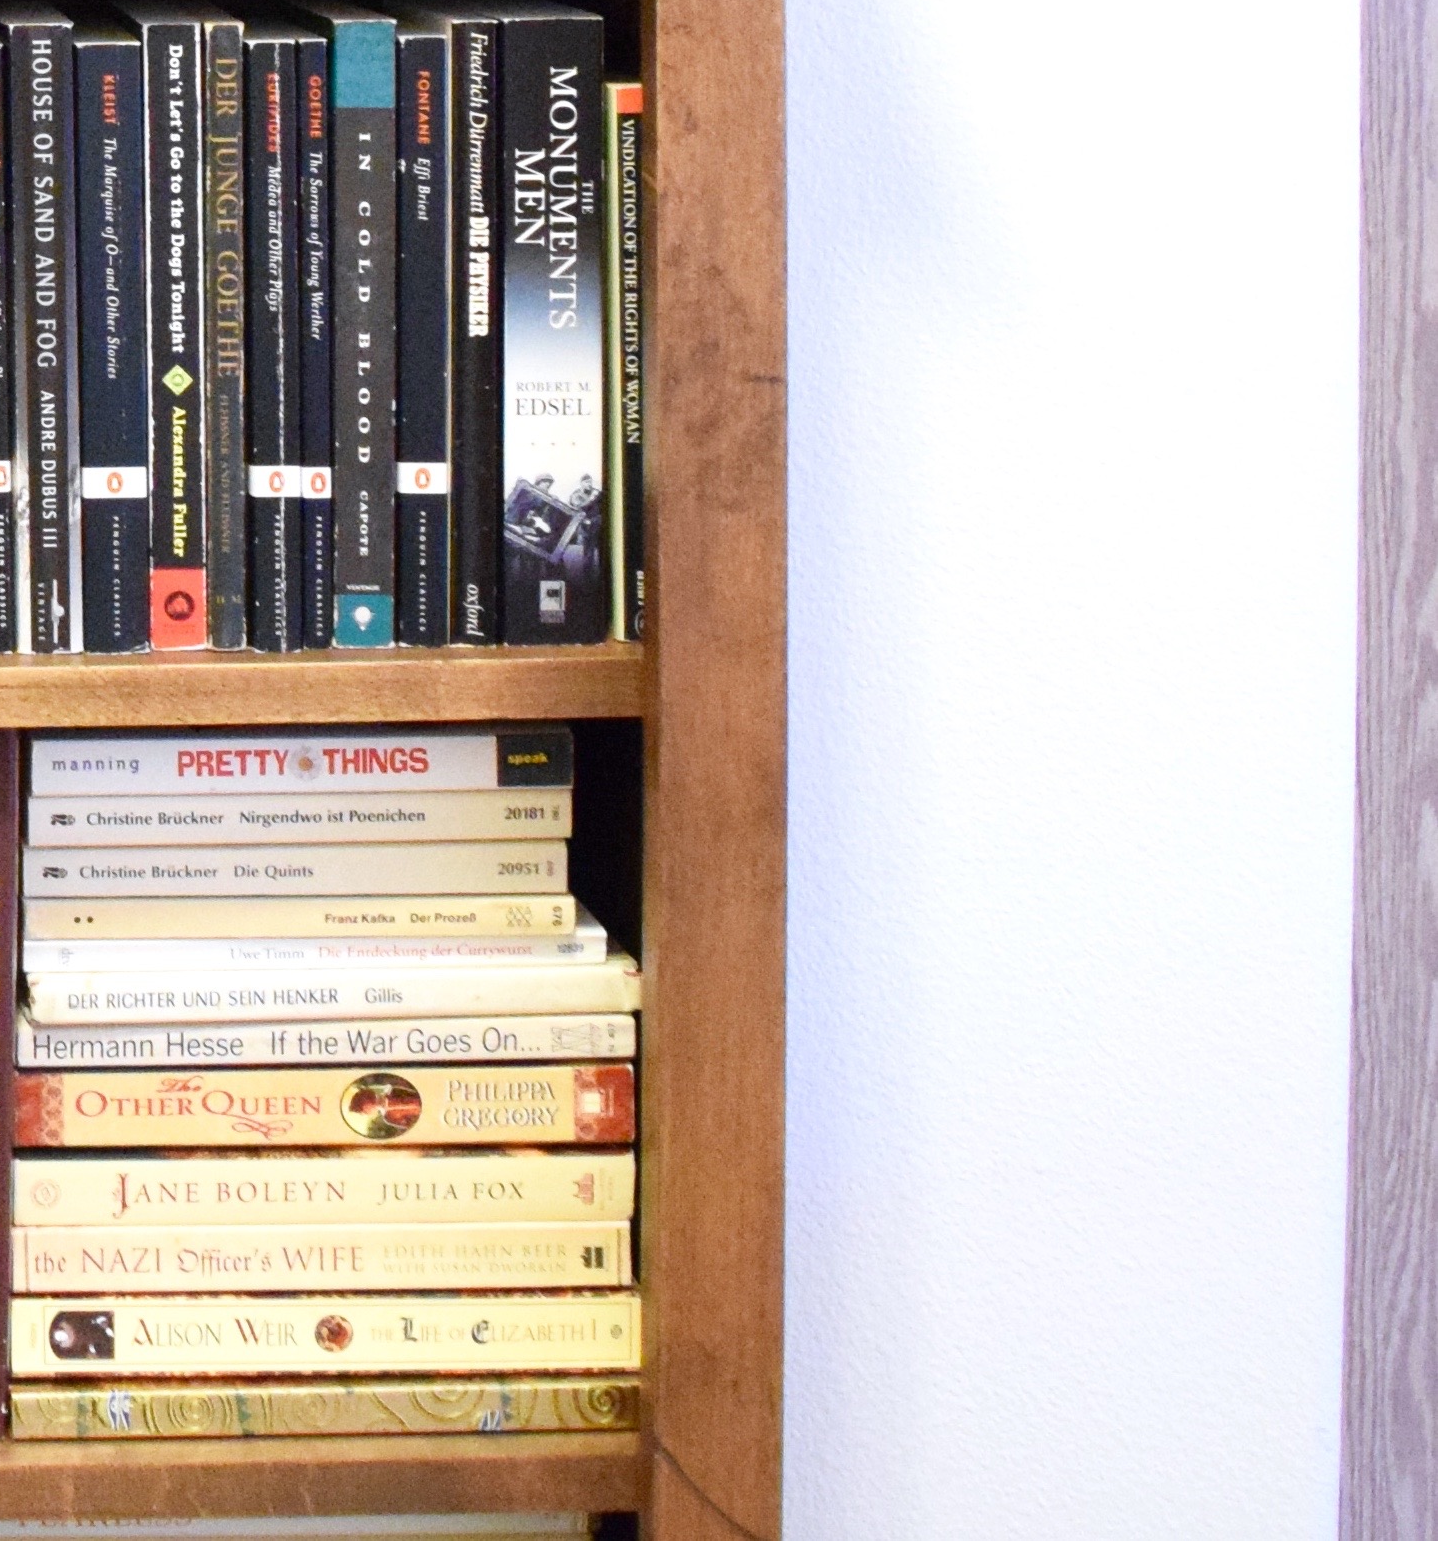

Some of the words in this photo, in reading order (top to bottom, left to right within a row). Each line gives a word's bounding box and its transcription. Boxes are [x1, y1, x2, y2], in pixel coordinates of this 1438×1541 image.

[358, 132, 371, 170] IN
[516, 149, 544, 247] MEN
[549, 66, 578, 329] MONUMENTS
[358, 200, 372, 303] COLD
[358, 333, 372, 463] BLOOD
[359, 490, 369, 556] CAPOTE
[51, 758, 141, 775] manning
[177, 748, 288, 777] PRETTY
[322, 748, 429, 774] THINGS
[86, 811, 153, 827] Christine
[157, 811, 224, 827] Brückner
[239, 811, 322, 826] Nirgendwo
[326, 811, 344, 824] ist
[348, 810, 426, 824] Poenichen
[504, 807, 546, 821] 20181
[32, 1034, 155, 1059] Hermann
[165, 1033, 244, 1057] Hesse
[269, 1033, 286, 1056] If
[296, 1031, 338, 1056] the
[348, 1031, 398, 1053] War
[408, 1030, 472, 1053] Goes
